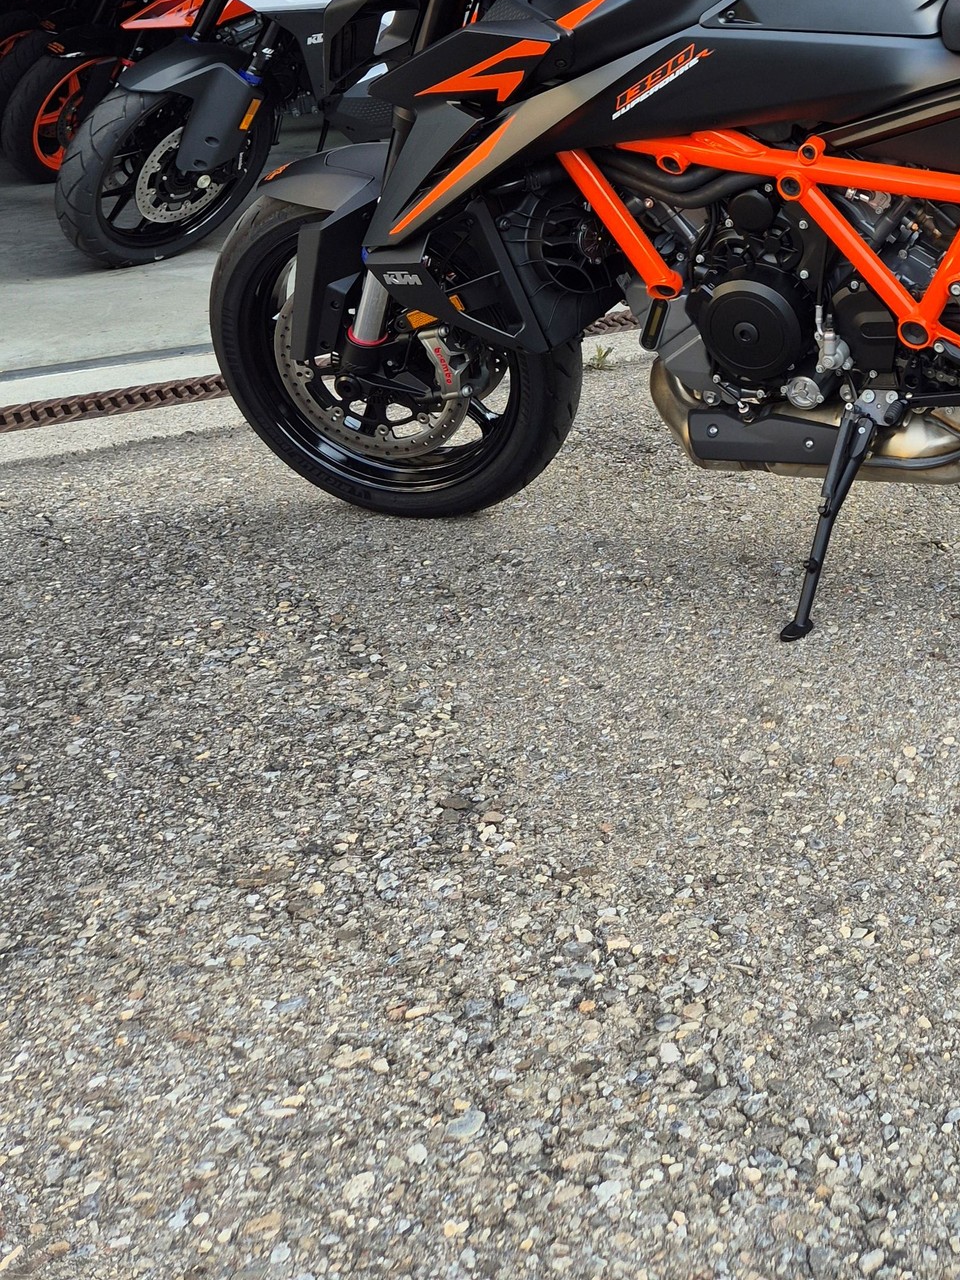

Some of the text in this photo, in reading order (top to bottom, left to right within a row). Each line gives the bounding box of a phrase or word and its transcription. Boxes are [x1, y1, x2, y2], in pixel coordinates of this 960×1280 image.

[306, 33, 323, 46] KT
[616, 42, 695, 110] 1390
[382, 271, 423, 286] KTM
[434, 347, 453, 384] brembo
